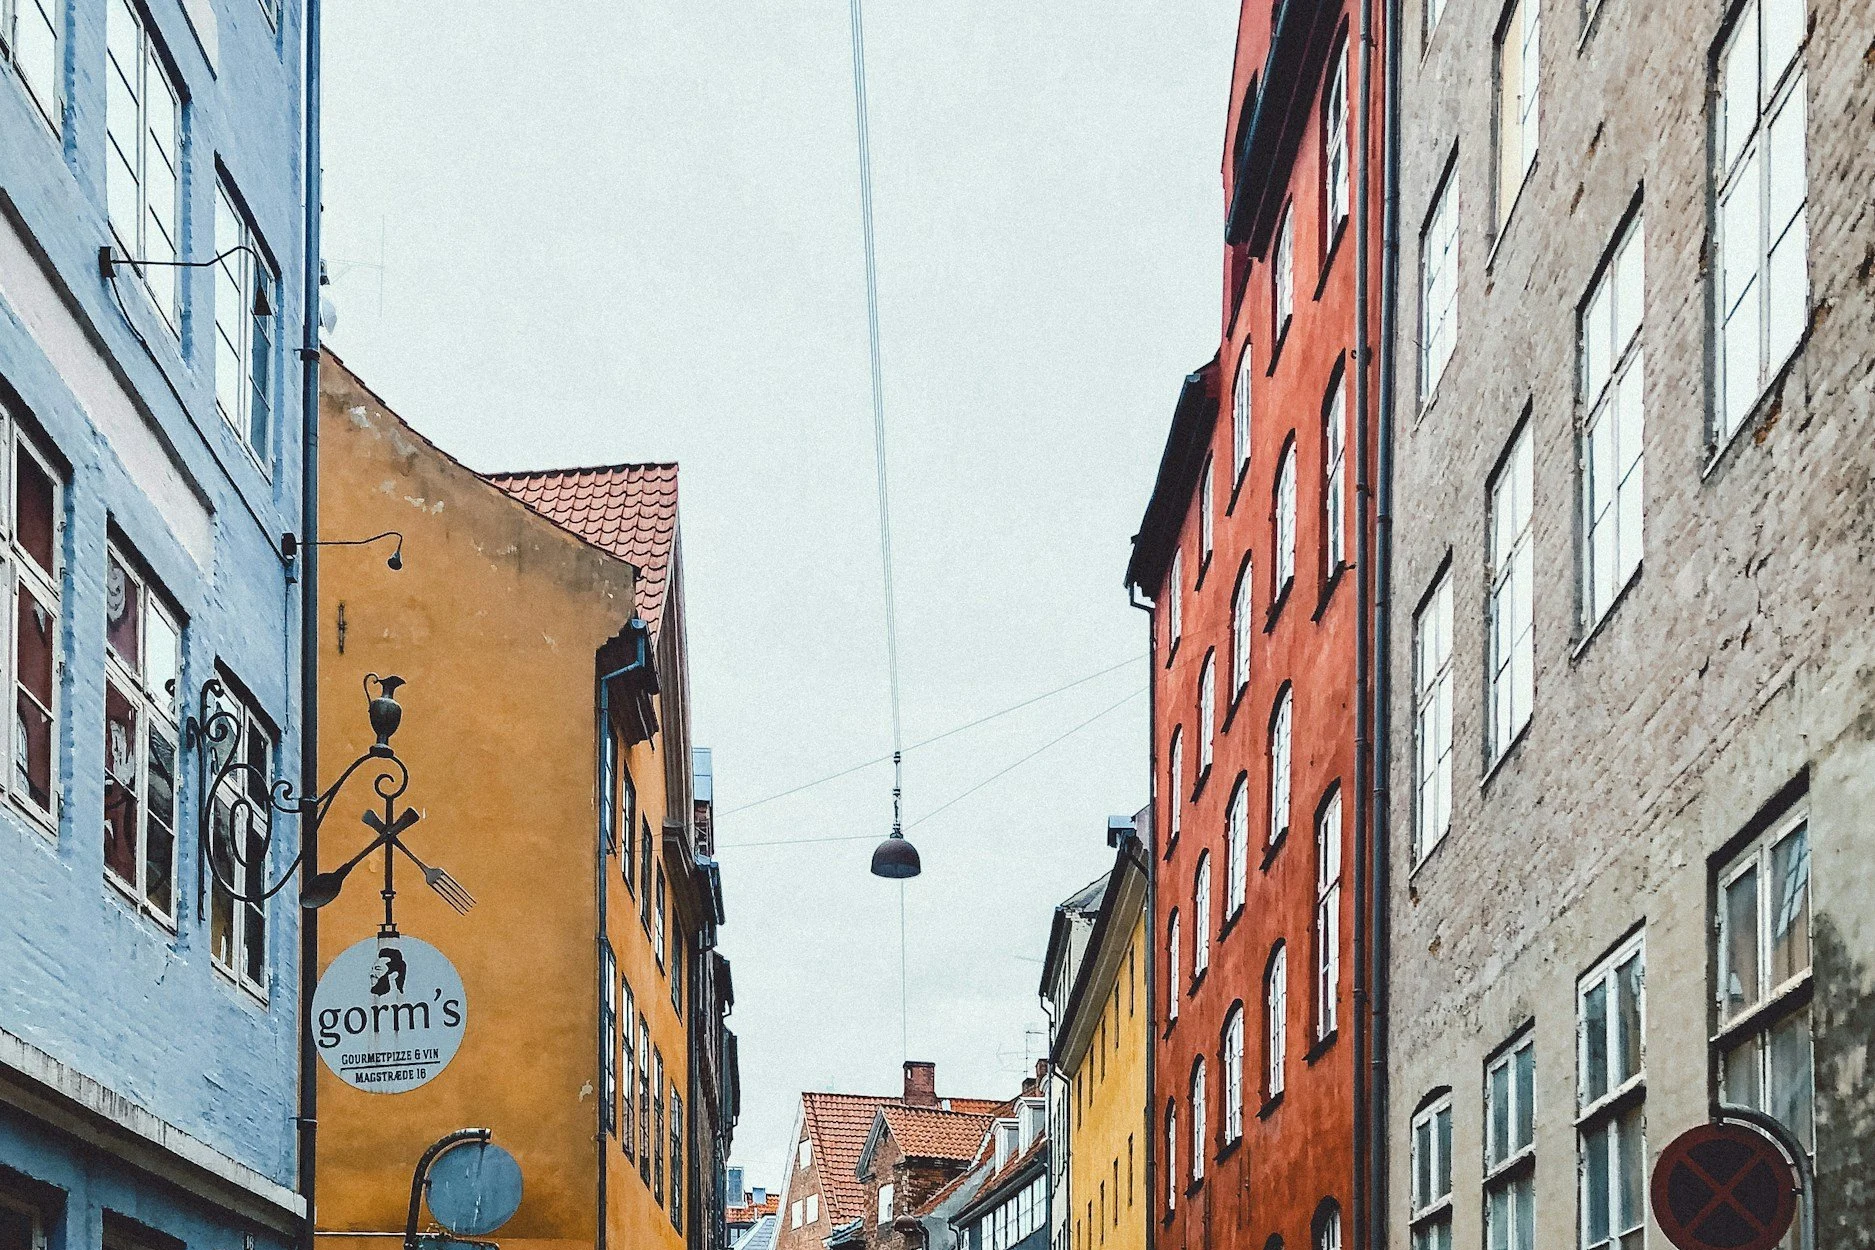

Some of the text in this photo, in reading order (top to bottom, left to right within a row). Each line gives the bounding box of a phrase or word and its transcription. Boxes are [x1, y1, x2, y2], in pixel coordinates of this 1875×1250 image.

[318, 988, 461, 1049] gorm's
[341, 1048, 439, 1065] GOURMETPIZZE & VIN
[355, 1069, 414, 1084] MAGSTRÆDE
